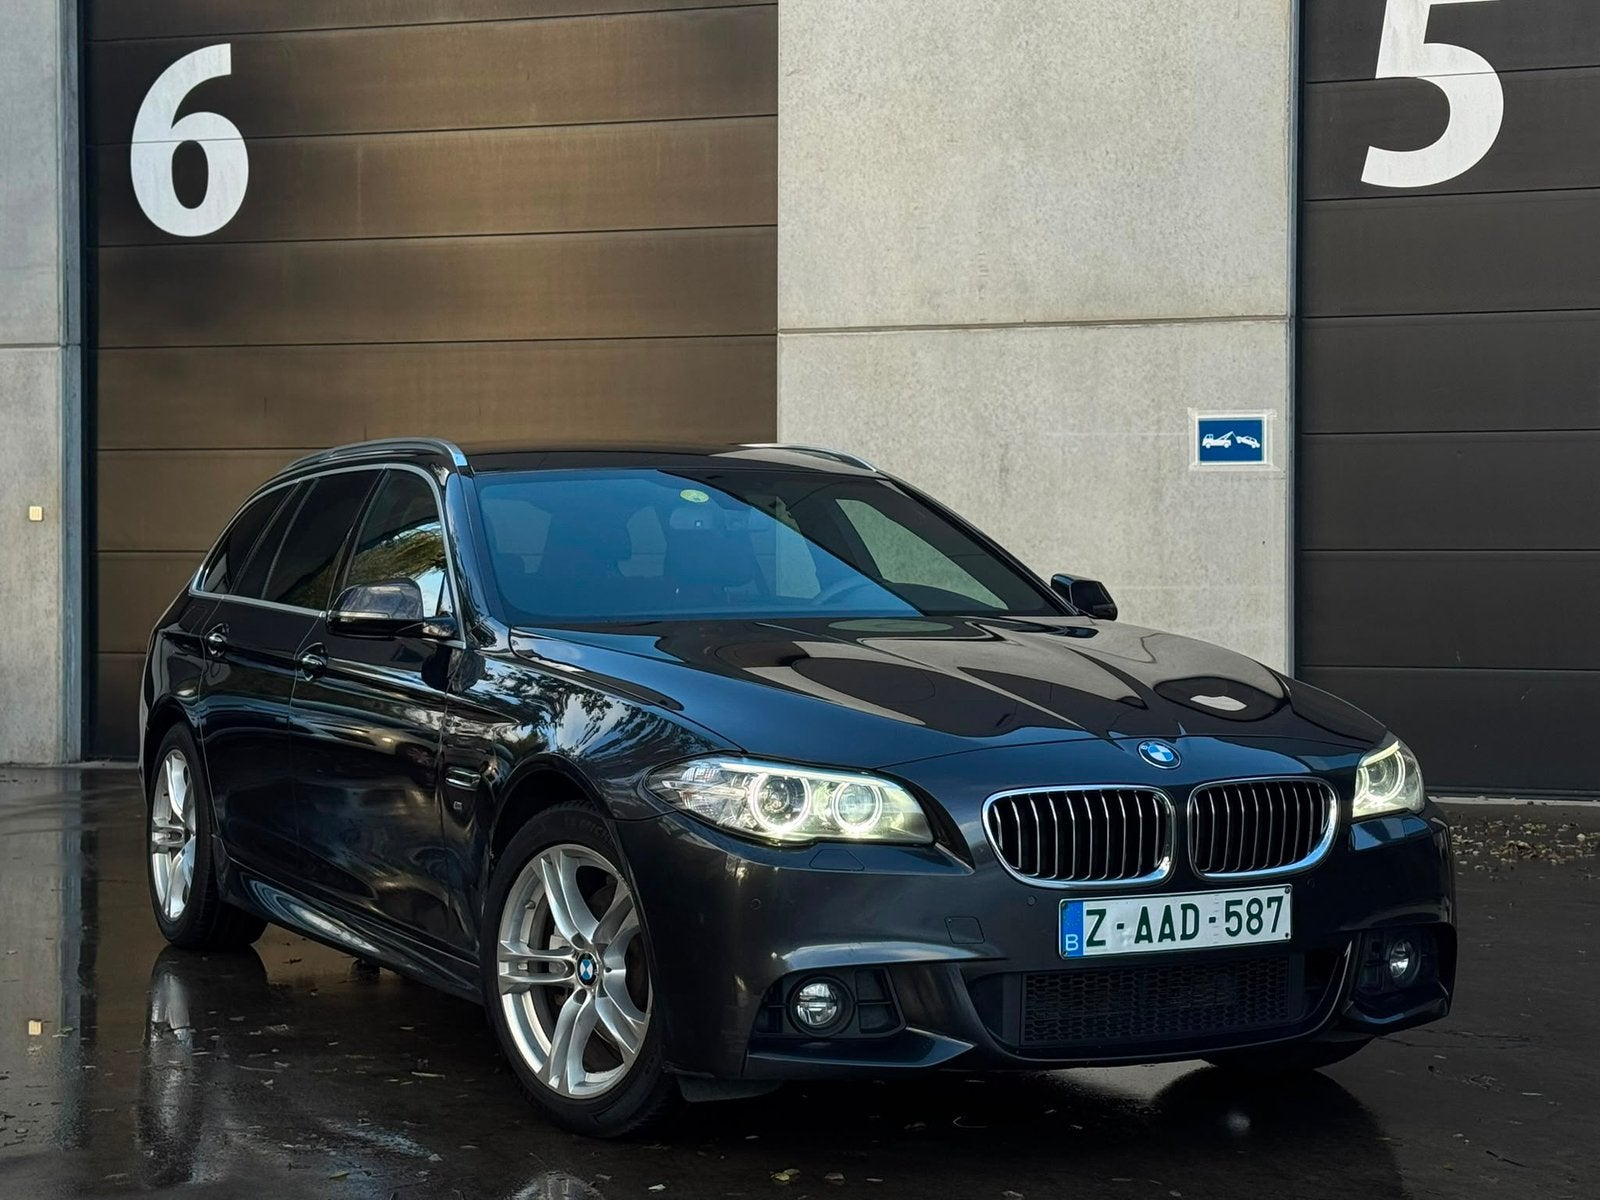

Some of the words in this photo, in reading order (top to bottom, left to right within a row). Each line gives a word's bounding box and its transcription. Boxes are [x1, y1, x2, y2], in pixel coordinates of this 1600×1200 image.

[130, 43, 249, 237] 6
[1361, 0, 1504, 188] 5
[1065, 934, 1079, 951] B
